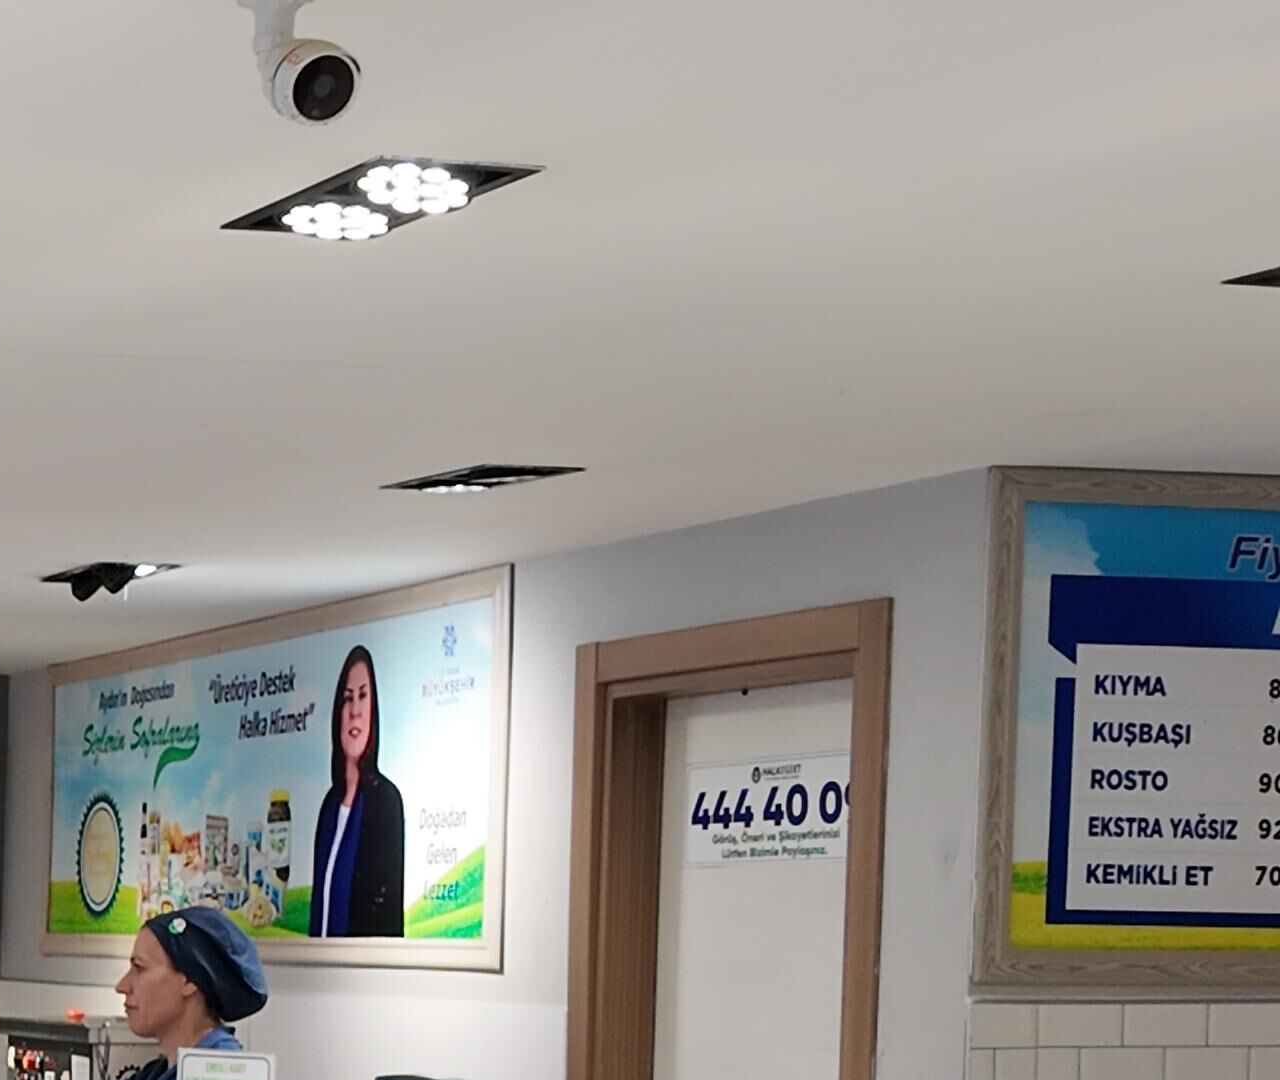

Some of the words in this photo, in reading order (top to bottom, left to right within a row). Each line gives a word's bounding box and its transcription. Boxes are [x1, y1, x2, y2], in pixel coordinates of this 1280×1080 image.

[260, 664, 295, 697] Destek
[1094, 674, 1166, 697] KIYMA
[238, 710, 269, 739] Halka
[1092, 721, 1191, 750] KUŞBAŞI
[1090, 768, 1168, 791] ROSTO
[691, 788, 754, 830] 444
[763, 783, 808, 826] 40
[819, 781, 850, 824] 0
[419, 808, 467, 835] Doğadan
[1088, 816, 1163, 838] EKSTRA
[1170, 813, 1238, 841] YAĞSIZ
[426, 842, 458, 865] Gelen
[1086, 862, 1177, 885] KEMİKLİ
[1185, 866, 1213, 886] ET
[423, 879, 459, 901] Lezzet
